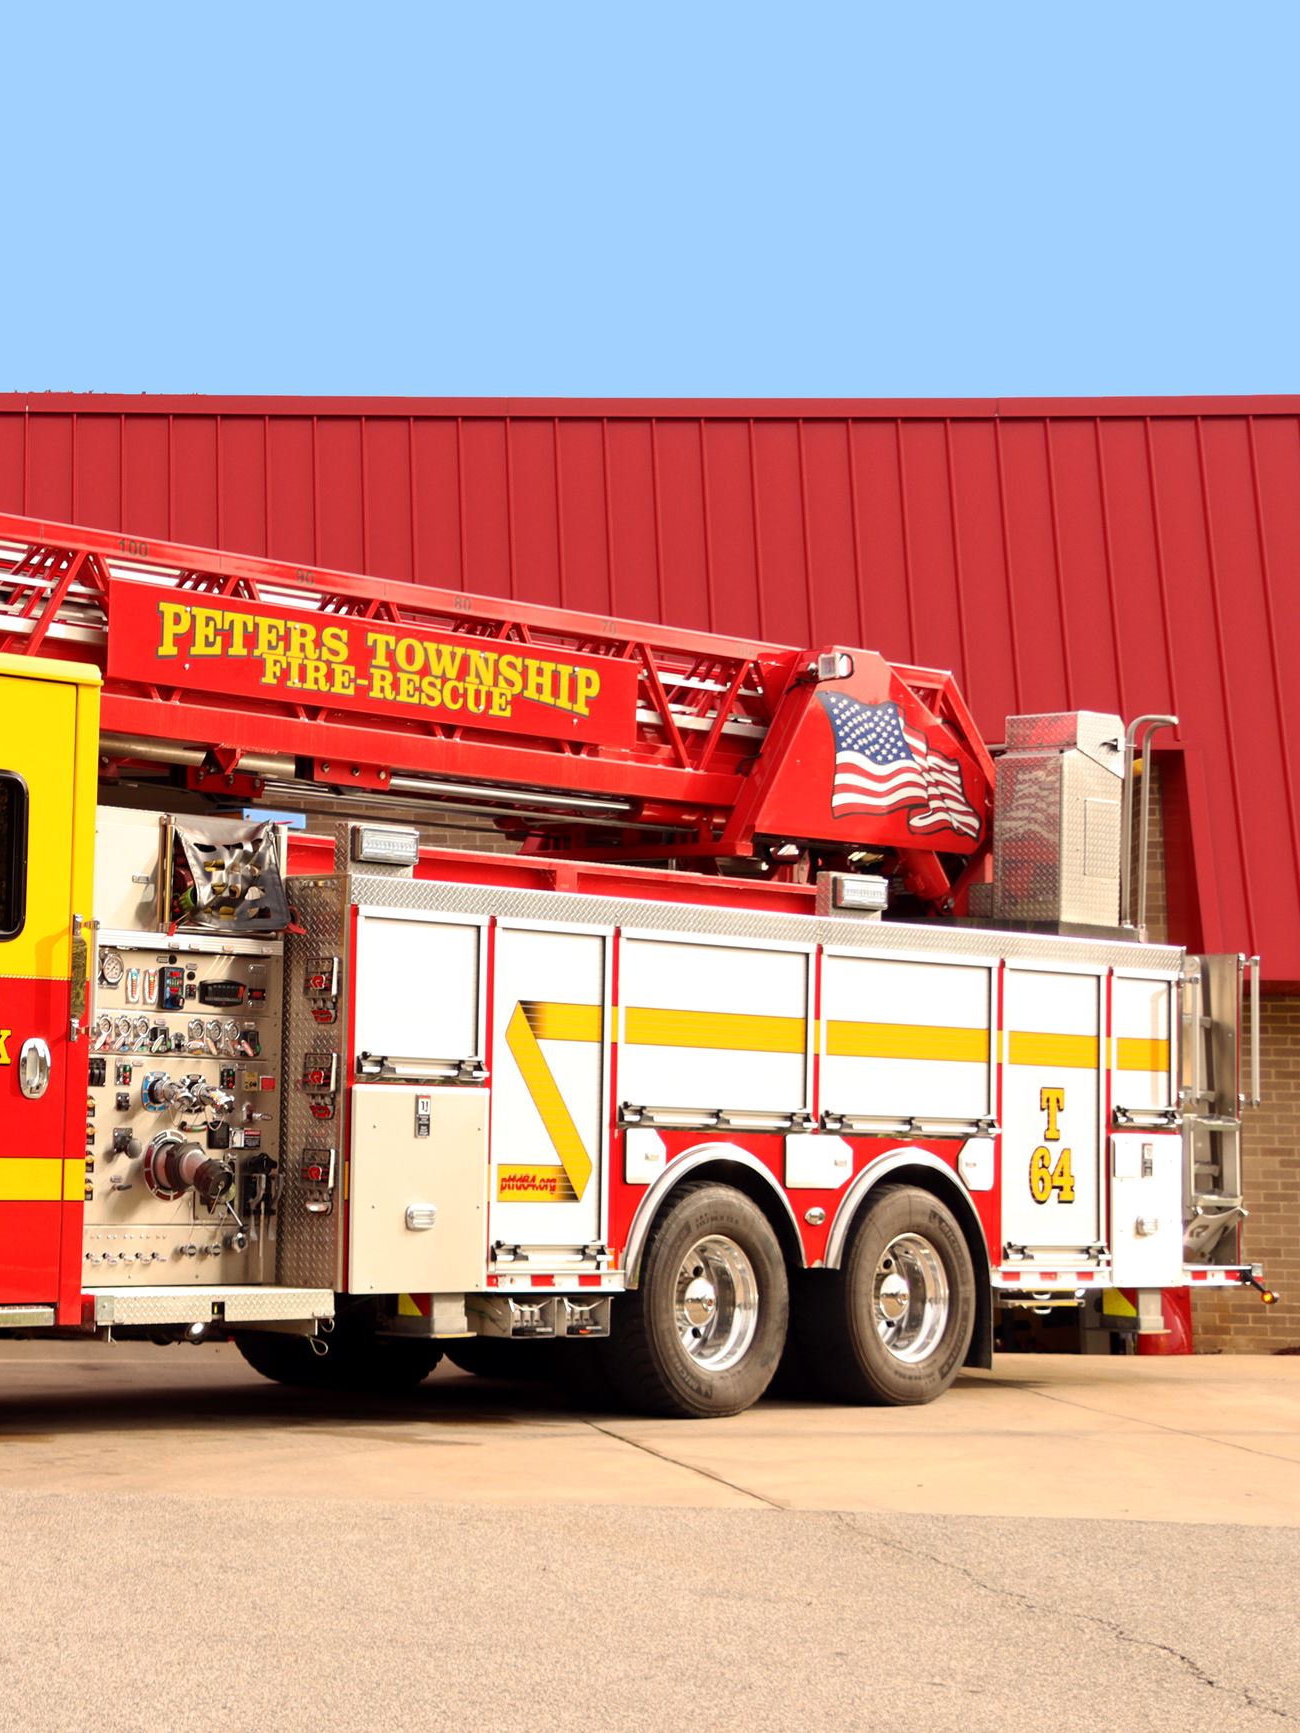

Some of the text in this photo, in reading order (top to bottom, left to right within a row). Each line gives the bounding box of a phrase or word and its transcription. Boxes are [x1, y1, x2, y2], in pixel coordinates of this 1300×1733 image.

[118, 539, 149, 558] 100
[295, 569, 315, 585] 90
[156, 601, 601, 717] PETERS TOWNSHIP
[260, 653, 512, 718] FIRE-RESCUE
[1039, 1086, 1065, 1142] T
[1028, 1145, 1075, 1204] 64
